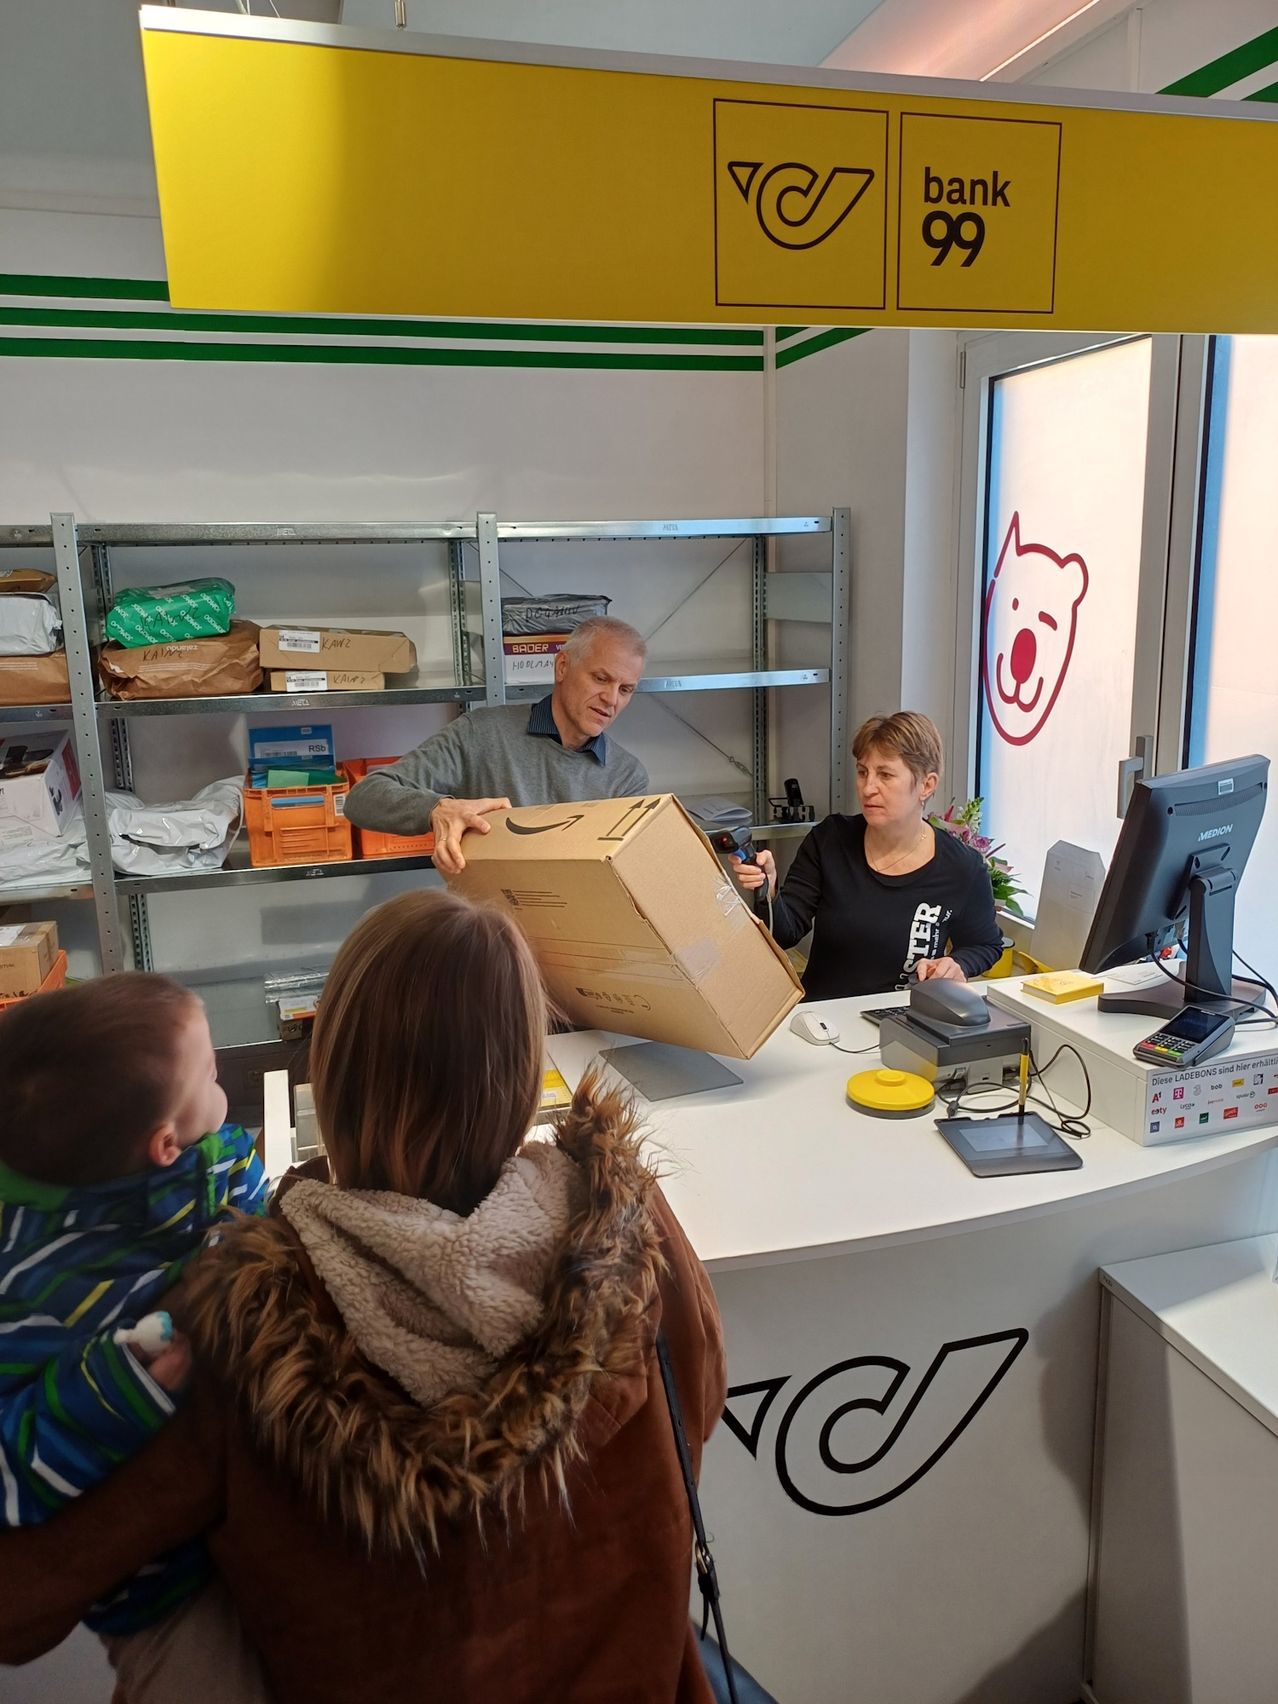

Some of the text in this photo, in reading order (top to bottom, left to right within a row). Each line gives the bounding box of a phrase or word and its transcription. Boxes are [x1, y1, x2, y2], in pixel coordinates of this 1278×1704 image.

[923, 166, 1012, 207] bank
[922, 210, 986, 268] 99
[512, 643, 549, 653] BADER
[308, 744, 327, 753] RSb
[1197, 823, 1234, 842] MEDION
[1152, 1076, 1173, 1087] Diese
[1175, 1067, 1218, 1082] LADEBONS
[1218, 1064, 1235, 1075] sind
[1236, 1062, 1251, 1071] hier
